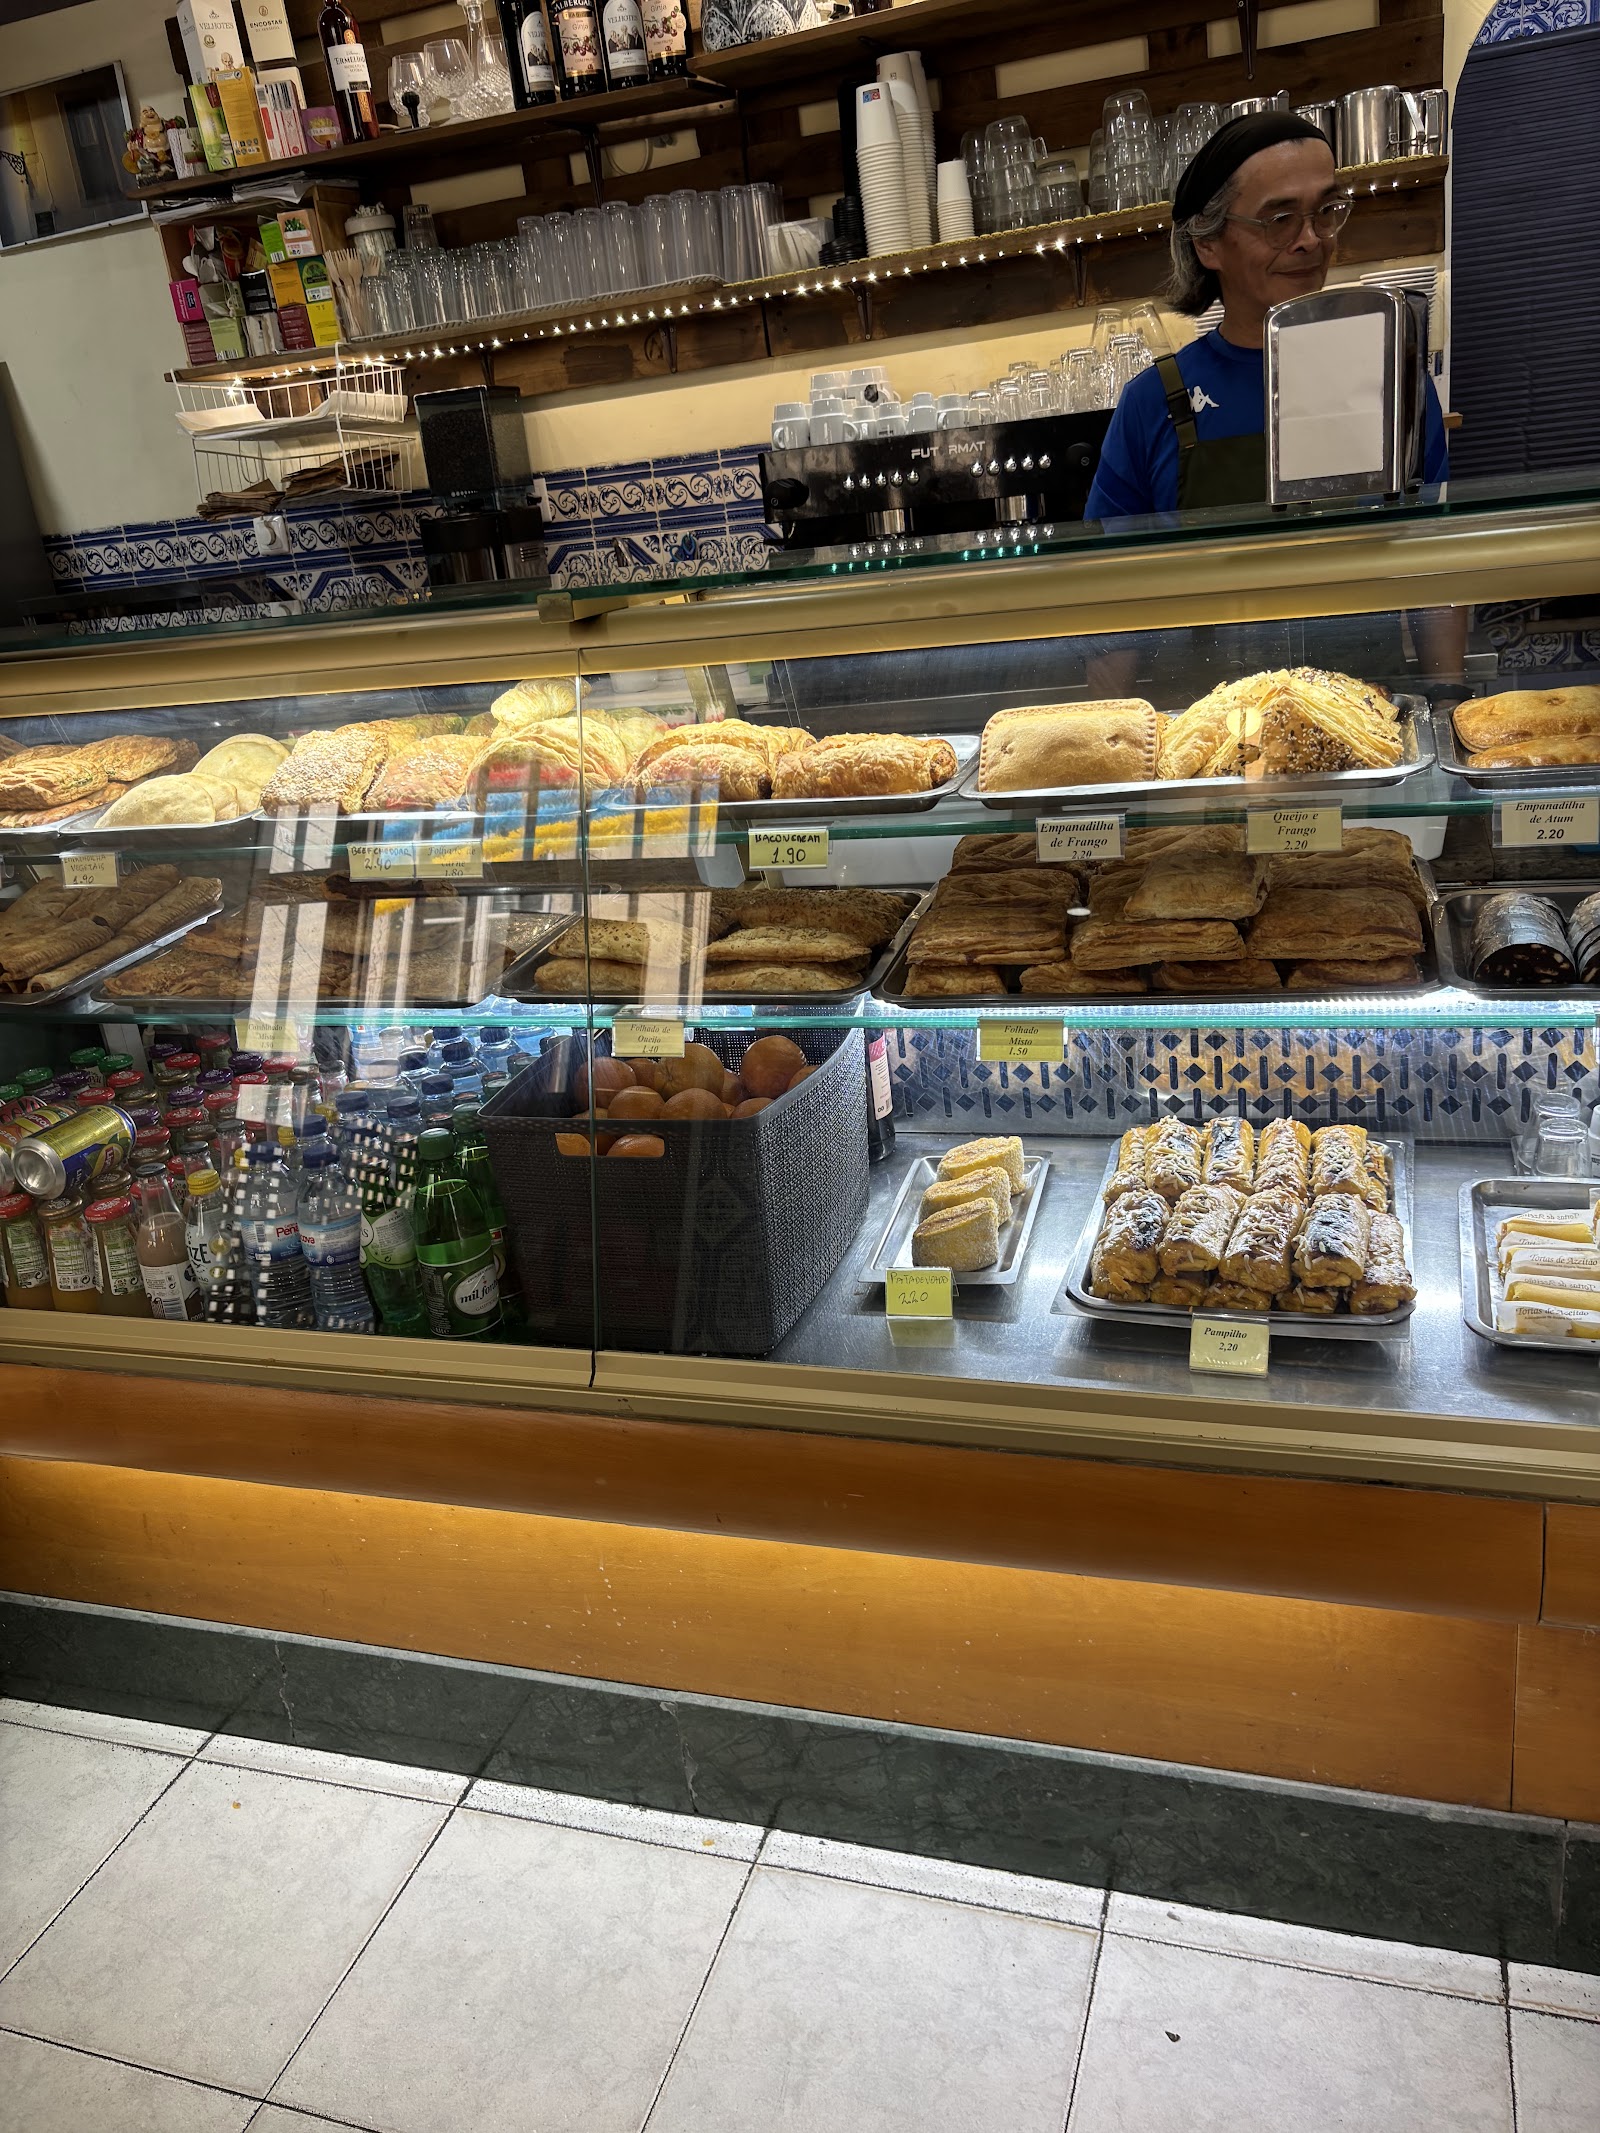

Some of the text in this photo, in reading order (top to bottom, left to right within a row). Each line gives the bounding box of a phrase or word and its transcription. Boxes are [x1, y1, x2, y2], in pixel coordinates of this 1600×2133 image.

[199, 22, 234, 30] VELHOTES
[249, 19, 283, 29] ENCOSTAS
[911, 441, 986, 459] FUTRMAT
[1515, 801, 1585, 812] Empanadilha
[1273, 811, 1308, 823] Queijo
[1529, 815, 1574, 823] de Atum
[1040, 821, 1114, 834] Empanadilha
[1277, 826, 1317, 837] Frango
[1537, 829, 1564, 840] 2.20
[1050, 837, 1108, 848] de Frango
[1283, 840, 1308, 850] 2.20
[771, 847, 806, 864] 1.90
[365, 858, 392, 870] 2.40
[73, 874, 94, 884] 1.90
[630, 1023, 660, 1033] Folhado
[1004, 1025, 1039, 1034] Folhado
[637, 1035, 662, 1043] Queijo
[1008, 1037, 1033, 1045] Misto
[642, 1045, 659, 1053] 1.40
[1009, 1047, 1028, 1056] 1.50
[1530, 1253, 1553, 1263] Tortas
[1566, 1257, 1598, 1266] Azeitão
[1516, 1307, 1542, 1316] Tortas
[1204, 1327, 1247, 1339] Pampilho
[1219, 1342, 1238, 1351] 2,20
